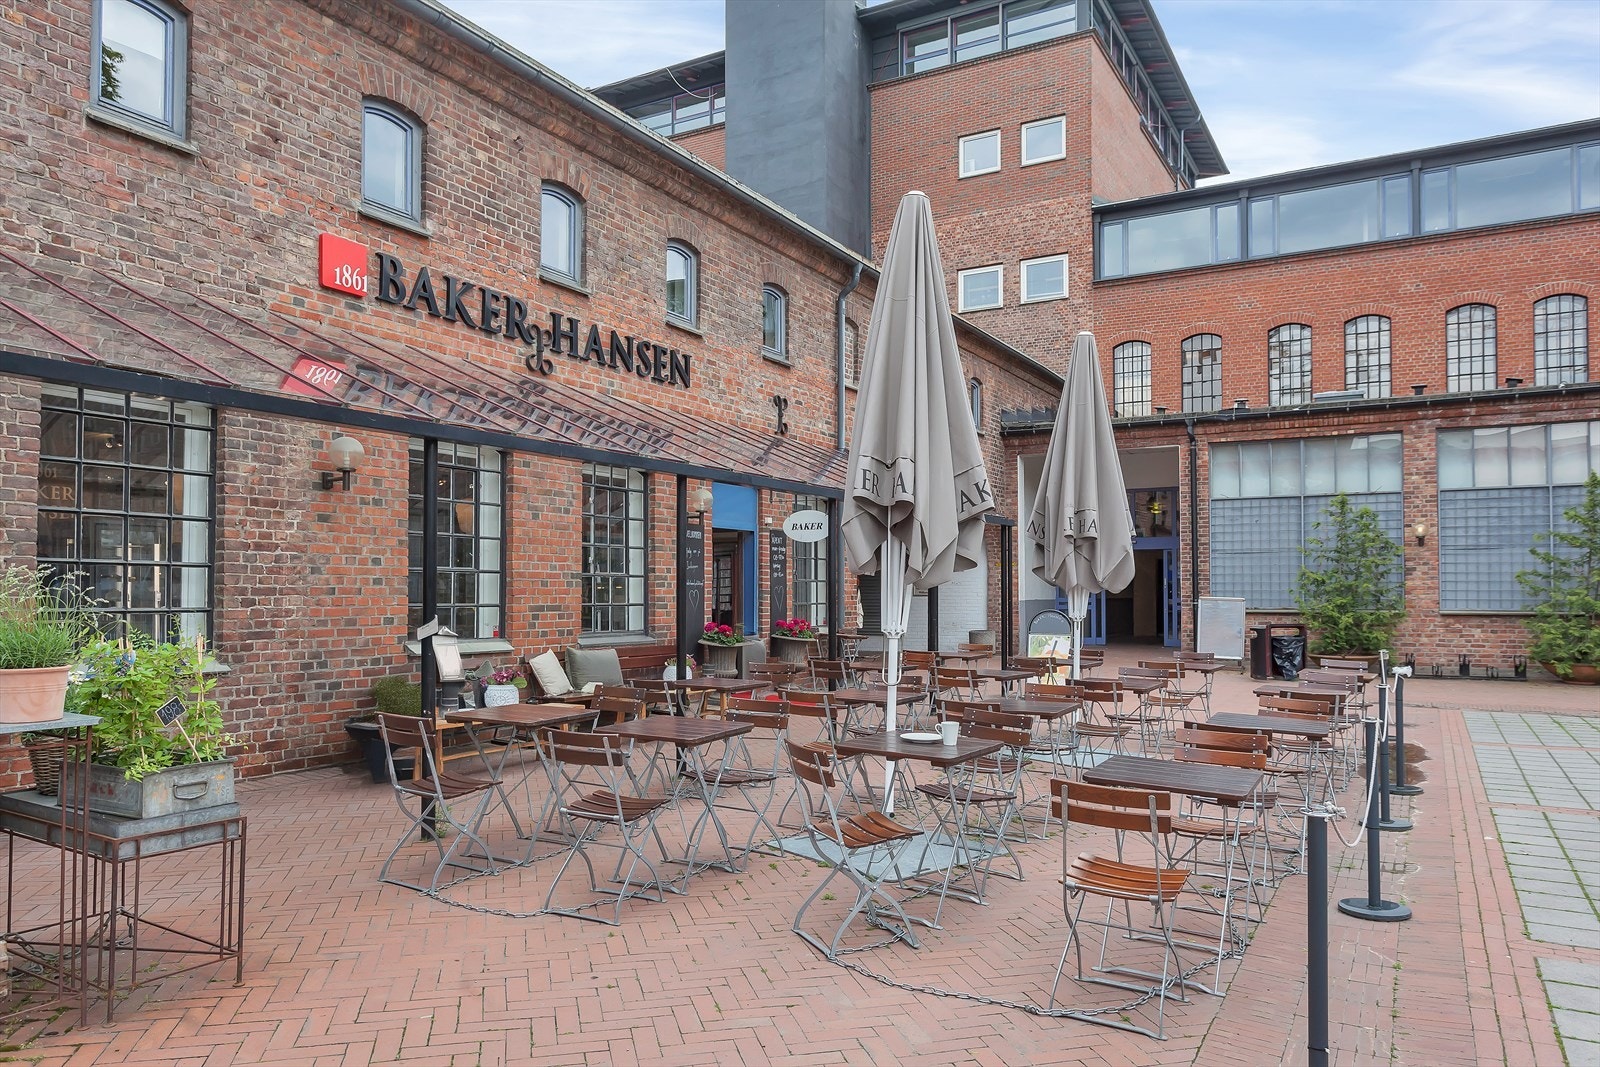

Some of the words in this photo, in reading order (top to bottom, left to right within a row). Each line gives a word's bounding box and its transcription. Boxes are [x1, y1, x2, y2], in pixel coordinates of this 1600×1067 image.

[334, 264, 368, 293] 1861
[375, 252, 534, 345] BAKER
[550, 312, 692, 388] HANSEN
[40, 463, 57, 478] 61
[859, 467, 881, 497] ER
[791, 522, 823, 531] BAKER
